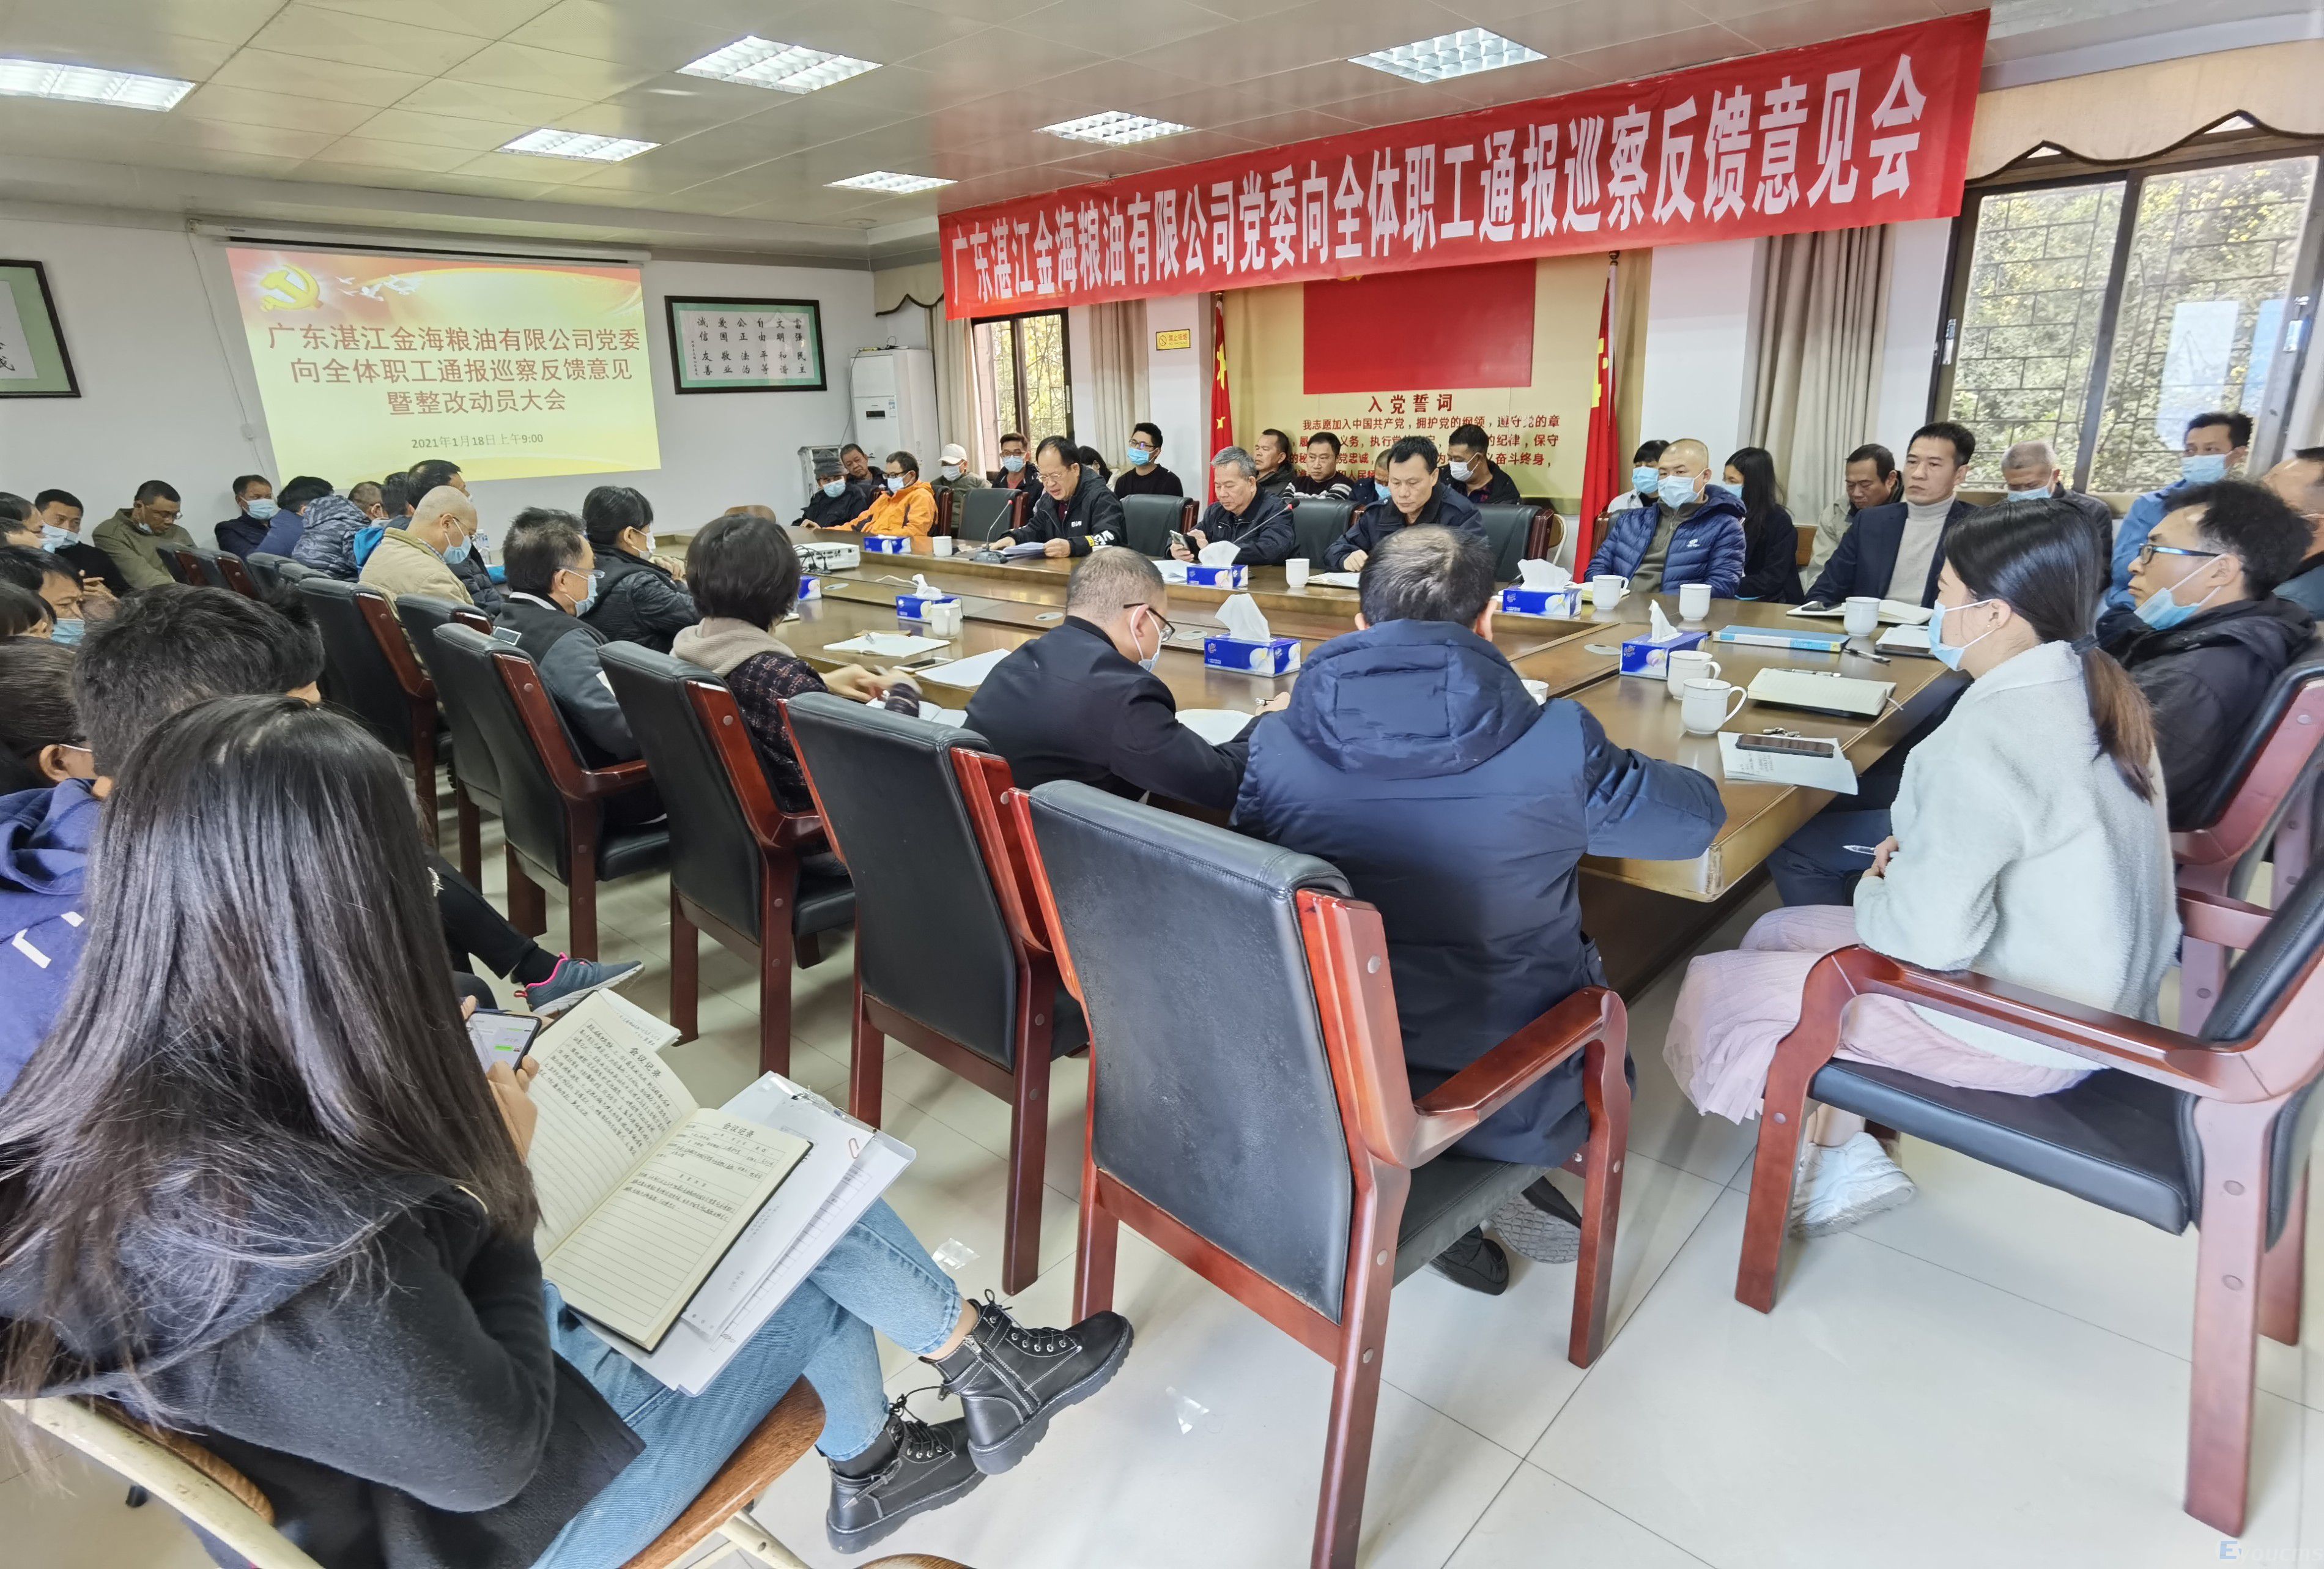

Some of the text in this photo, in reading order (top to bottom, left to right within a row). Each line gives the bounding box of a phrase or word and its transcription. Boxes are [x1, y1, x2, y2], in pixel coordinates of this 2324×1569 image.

[952, 53, 1926, 306] 广东湛江金海粮油有限公司党委向全体职工通报巡察反馈意见会
[268, 322, 640, 352] 广东湛江金海粮油有限公司党委
[290, 357, 632, 384] 向全体职工通报巡察反馈意见
[387, 388, 566, 415] 暨整改动员大会
[1367, 393, 1452, 415] 入党誓词
